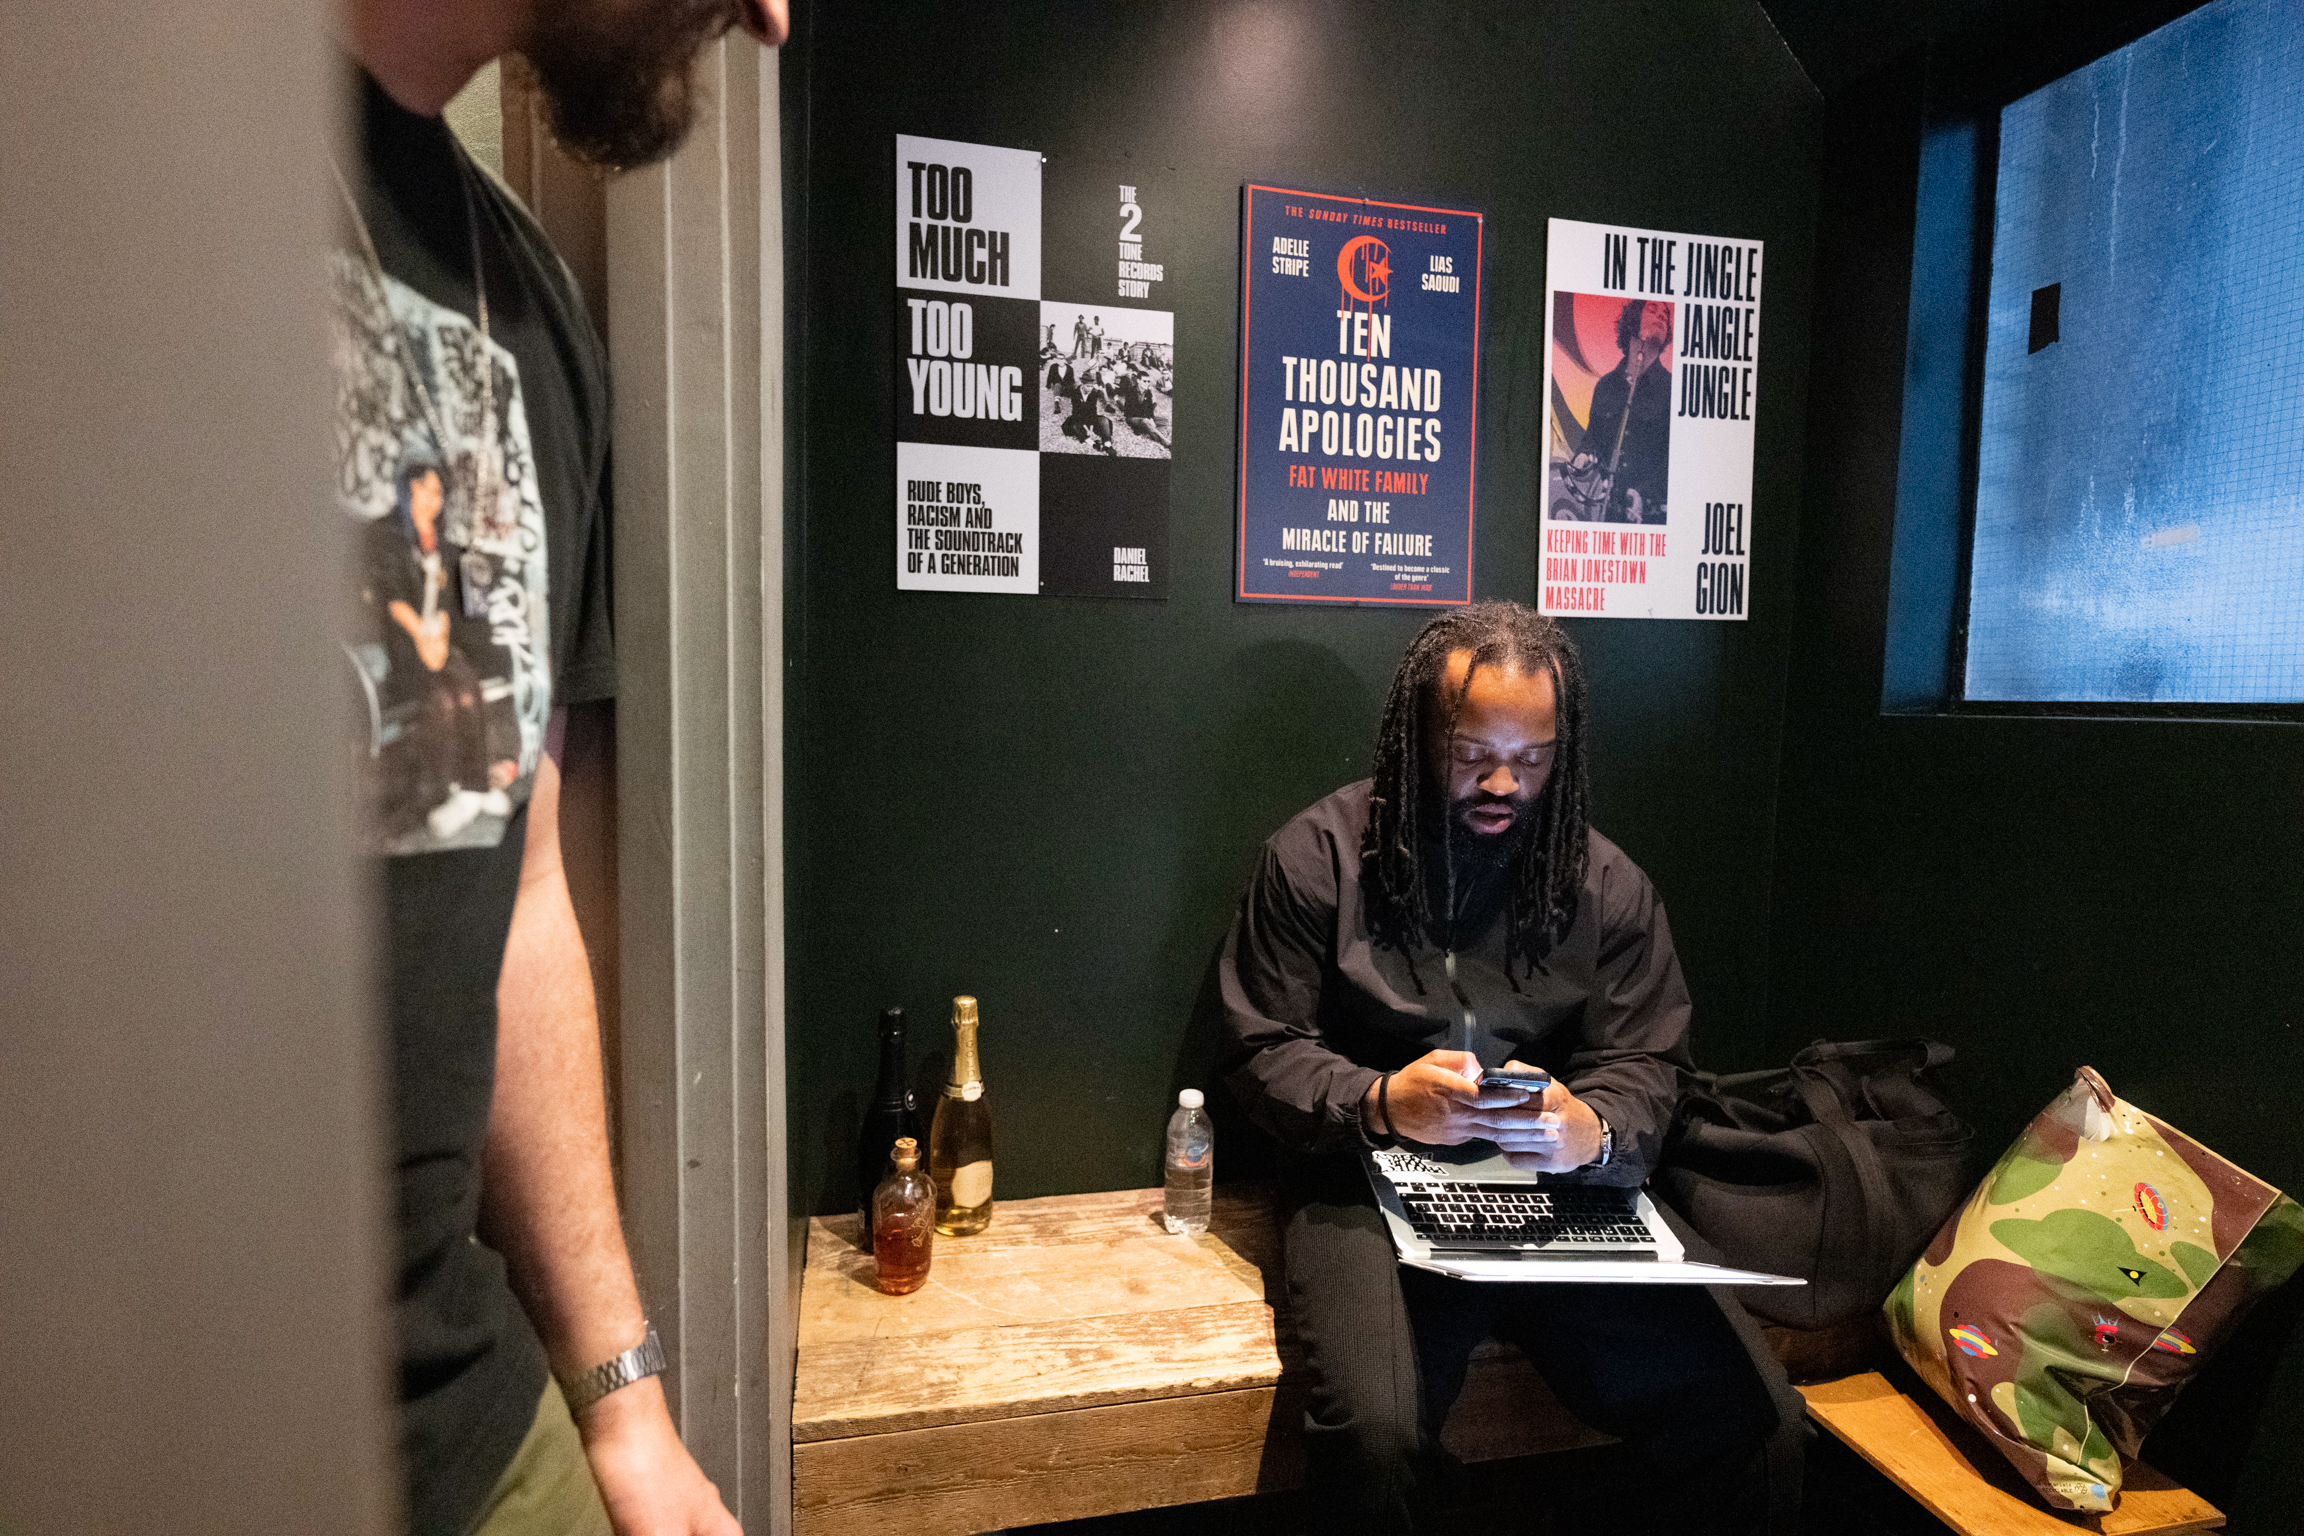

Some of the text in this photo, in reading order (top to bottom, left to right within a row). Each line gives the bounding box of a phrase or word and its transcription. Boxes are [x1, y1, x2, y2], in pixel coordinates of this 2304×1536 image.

[907, 161, 973, 224] TOO
[1119, 185, 1137, 204] THE
[1119, 202, 1142, 242] 2
[1286, 205, 1447, 235] THE SUNDAY TIMES BESTSELLER
[908, 222, 1010, 287] MUCH
[1119, 243, 1143, 261] TONE
[1272, 236, 1310, 258] ADELLE
[1119, 261, 1164, 282] RECORDS
[1272, 256, 1310, 278] STRIPE
[1430, 255, 1453, 274] LIAS
[1603, 233, 1758, 302] IN THE JINGLE
[1118, 280, 1150, 299] STORY
[1421, 273, 1460, 293] SAOUDI
[907, 299, 973, 359] TOO
[1337, 309, 1391, 359] TEN
[1680, 303, 1755, 362] JANGLE
[907, 358, 1023, 423] YOUNG
[1282, 356, 1441, 413] THOUSAND
[1678, 363, 1753, 421] JUNGLE
[1279, 407, 1441, 462] APOLOGIES
[1289, 465, 1429, 495] FAT WHITE FAMILY
[907, 480, 986, 509] RUDE BOYS,
[907, 505, 992, 530] RACISM AND
[1327, 499, 1390, 524] AND THE
[907, 528, 1023, 554] THE SOUNDTRACK
[1282, 527, 1433, 557] MIRACLE OF FAILURE
[1701, 502, 1745, 556] JOEL
[1546, 529, 1667, 557] KEEPING TIME WITH THE
[907, 553, 1019, 578] OF A GENERATION
[1113, 547, 1147, 567] DANIEL
[1295, 560, 1328, 570] exhilarating
[1405, 565, 1425, 573] become
[1431, 566, 1450, 574] classic
[1546, 557, 1646, 584] BRIAN JONESTOWN
[1113, 564, 1150, 583] RACHEL
[1395, 573, 1401, 581] of
[1545, 586, 1605, 611] MASSACRE
[1696, 562, 1743, 615] GION
